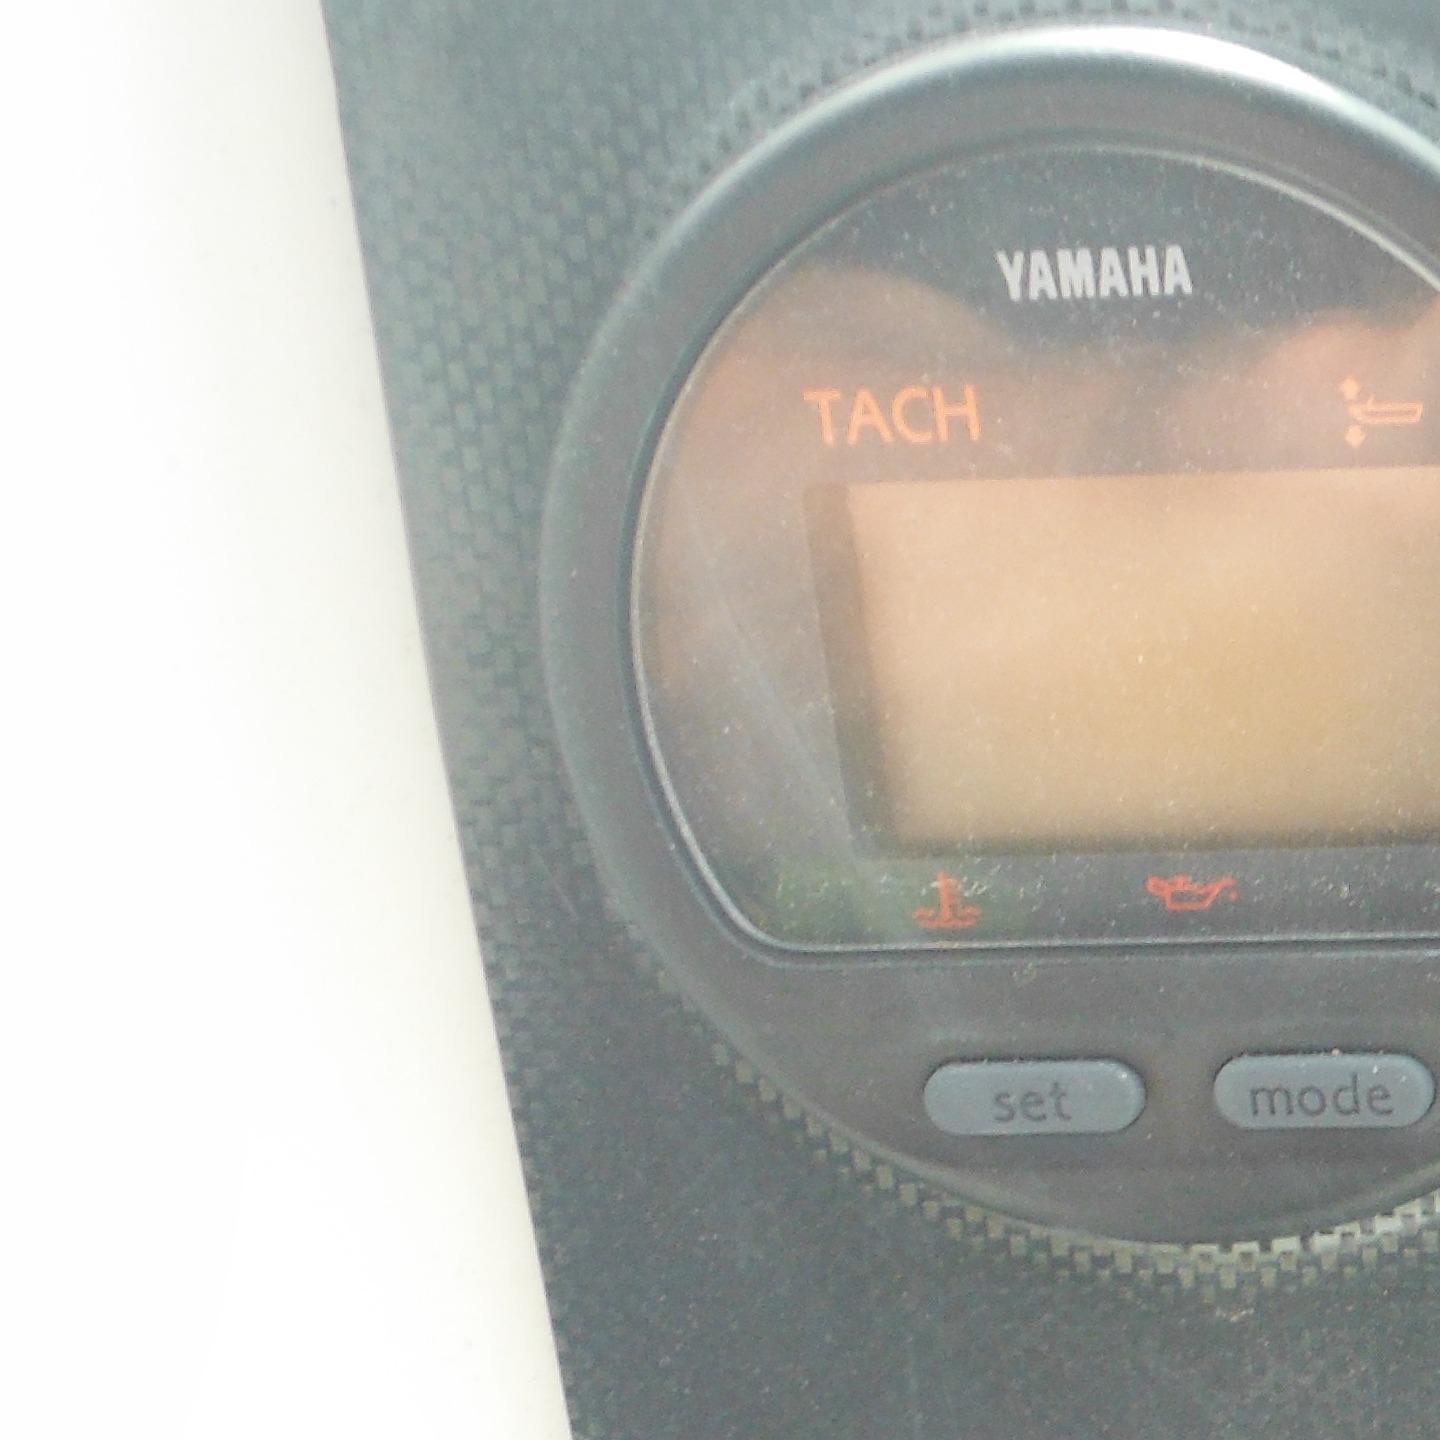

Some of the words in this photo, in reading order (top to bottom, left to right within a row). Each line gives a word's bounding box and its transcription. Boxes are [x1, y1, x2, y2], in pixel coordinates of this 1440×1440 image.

[997, 243, 1193, 302] YAMAHA
[803, 384, 983, 446] TACH
[991, 1080, 1072, 1124] set
[1248, 1072, 1395, 1118] mode
